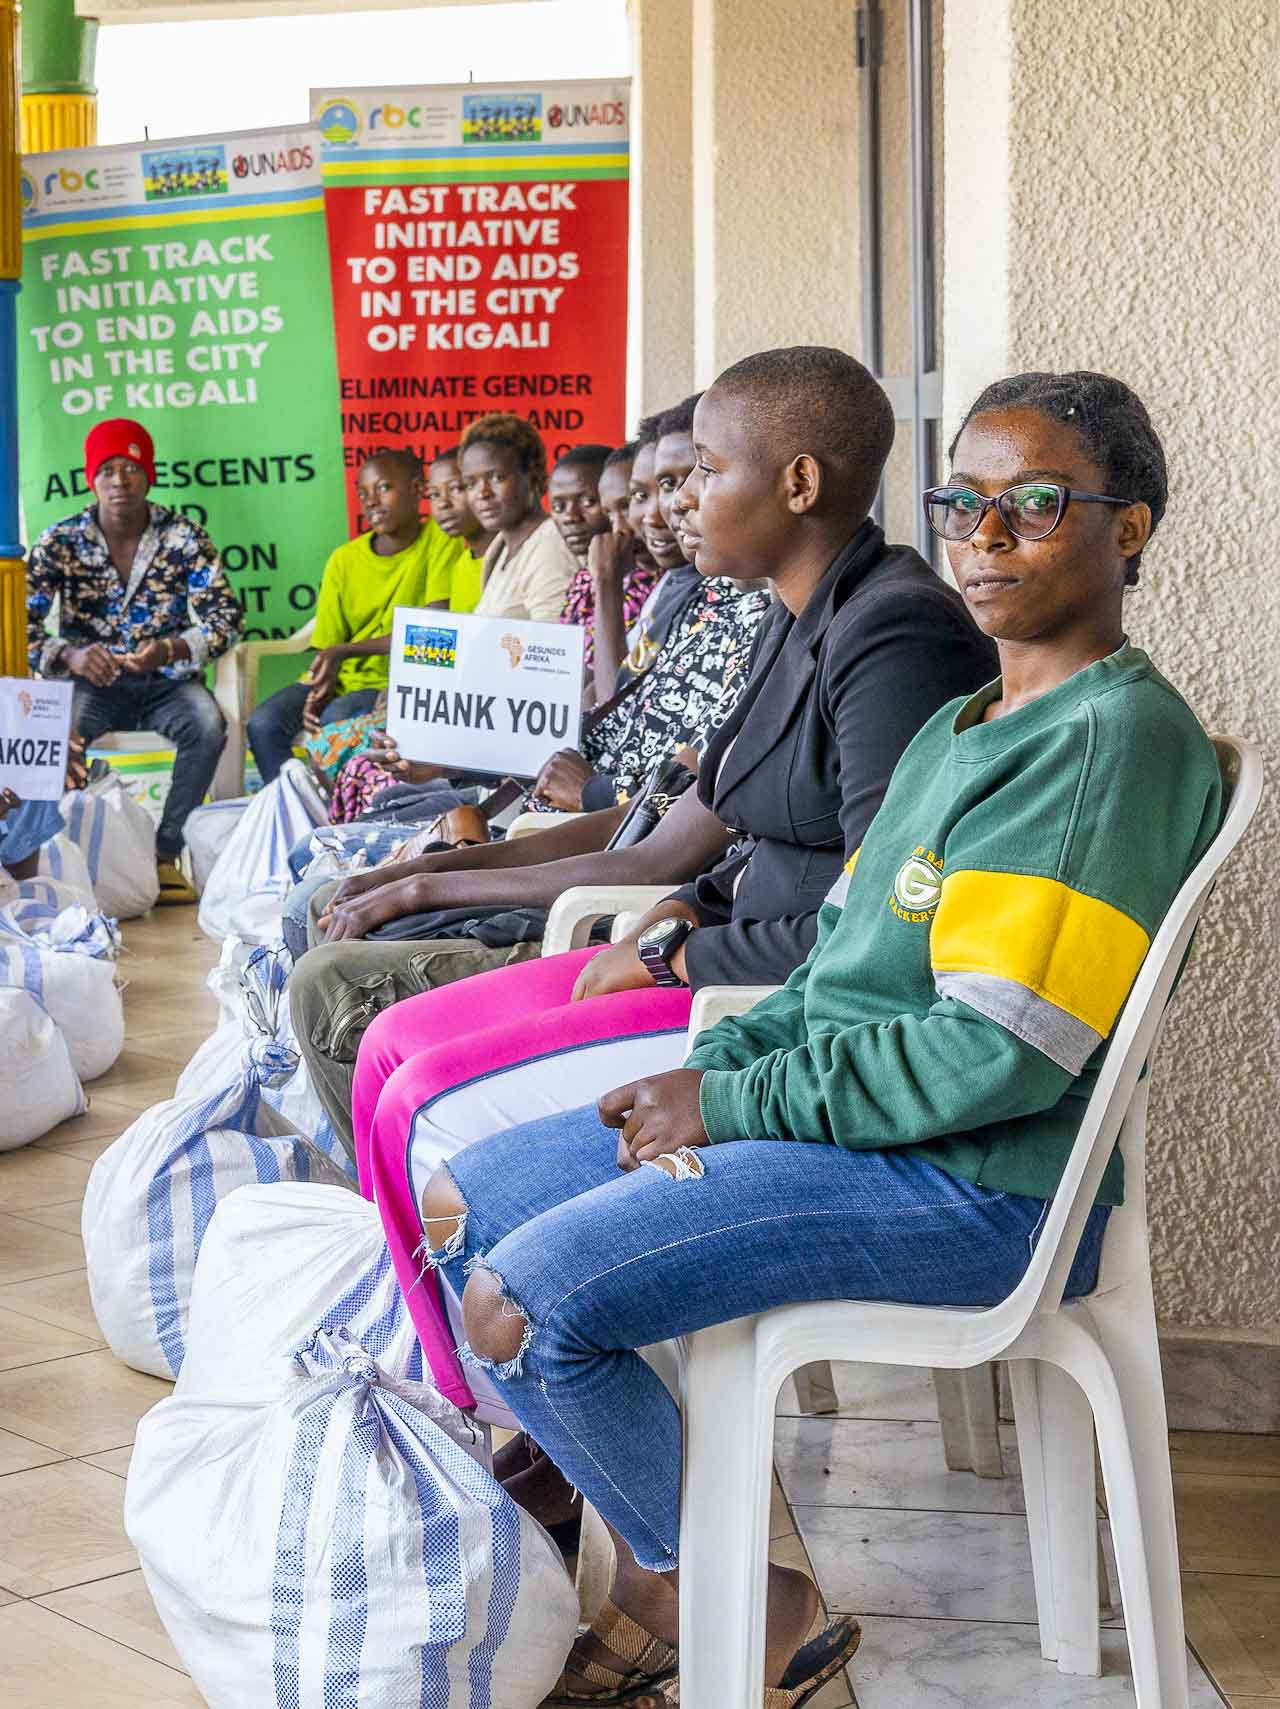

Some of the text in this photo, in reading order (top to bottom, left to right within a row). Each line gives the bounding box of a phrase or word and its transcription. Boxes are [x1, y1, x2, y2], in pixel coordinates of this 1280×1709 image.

[367, 104, 423, 131] rbc
[561, 102, 625, 127] UNAIDS
[250, 145, 313, 177] UNAIDS
[44, 168, 100, 195] rbc
[364, 183, 576, 215] FAST TRACK
[375, 219, 560, 249] INITIATIVE
[41, 234, 274, 281] FAST TRACK
[347, 252, 579, 284] TO END AIDS
[57, 271, 258, 313] INITIATIVE
[360, 287, 564, 317] IN THE CITY
[30, 305, 284, 352] TO END AIDS
[368, 321, 550, 351] OF KIGALI
[50, 341, 268, 384] IN THE CITY
[62, 377, 257, 415] OF KIGALI
[340, 375, 592, 399] ELIMINATE GENDER
[340, 408, 583, 433] INEQUALIT AND
[43, 453, 317, 502] ADESCENTS
[397, 685, 569, 739] THANK YOU
